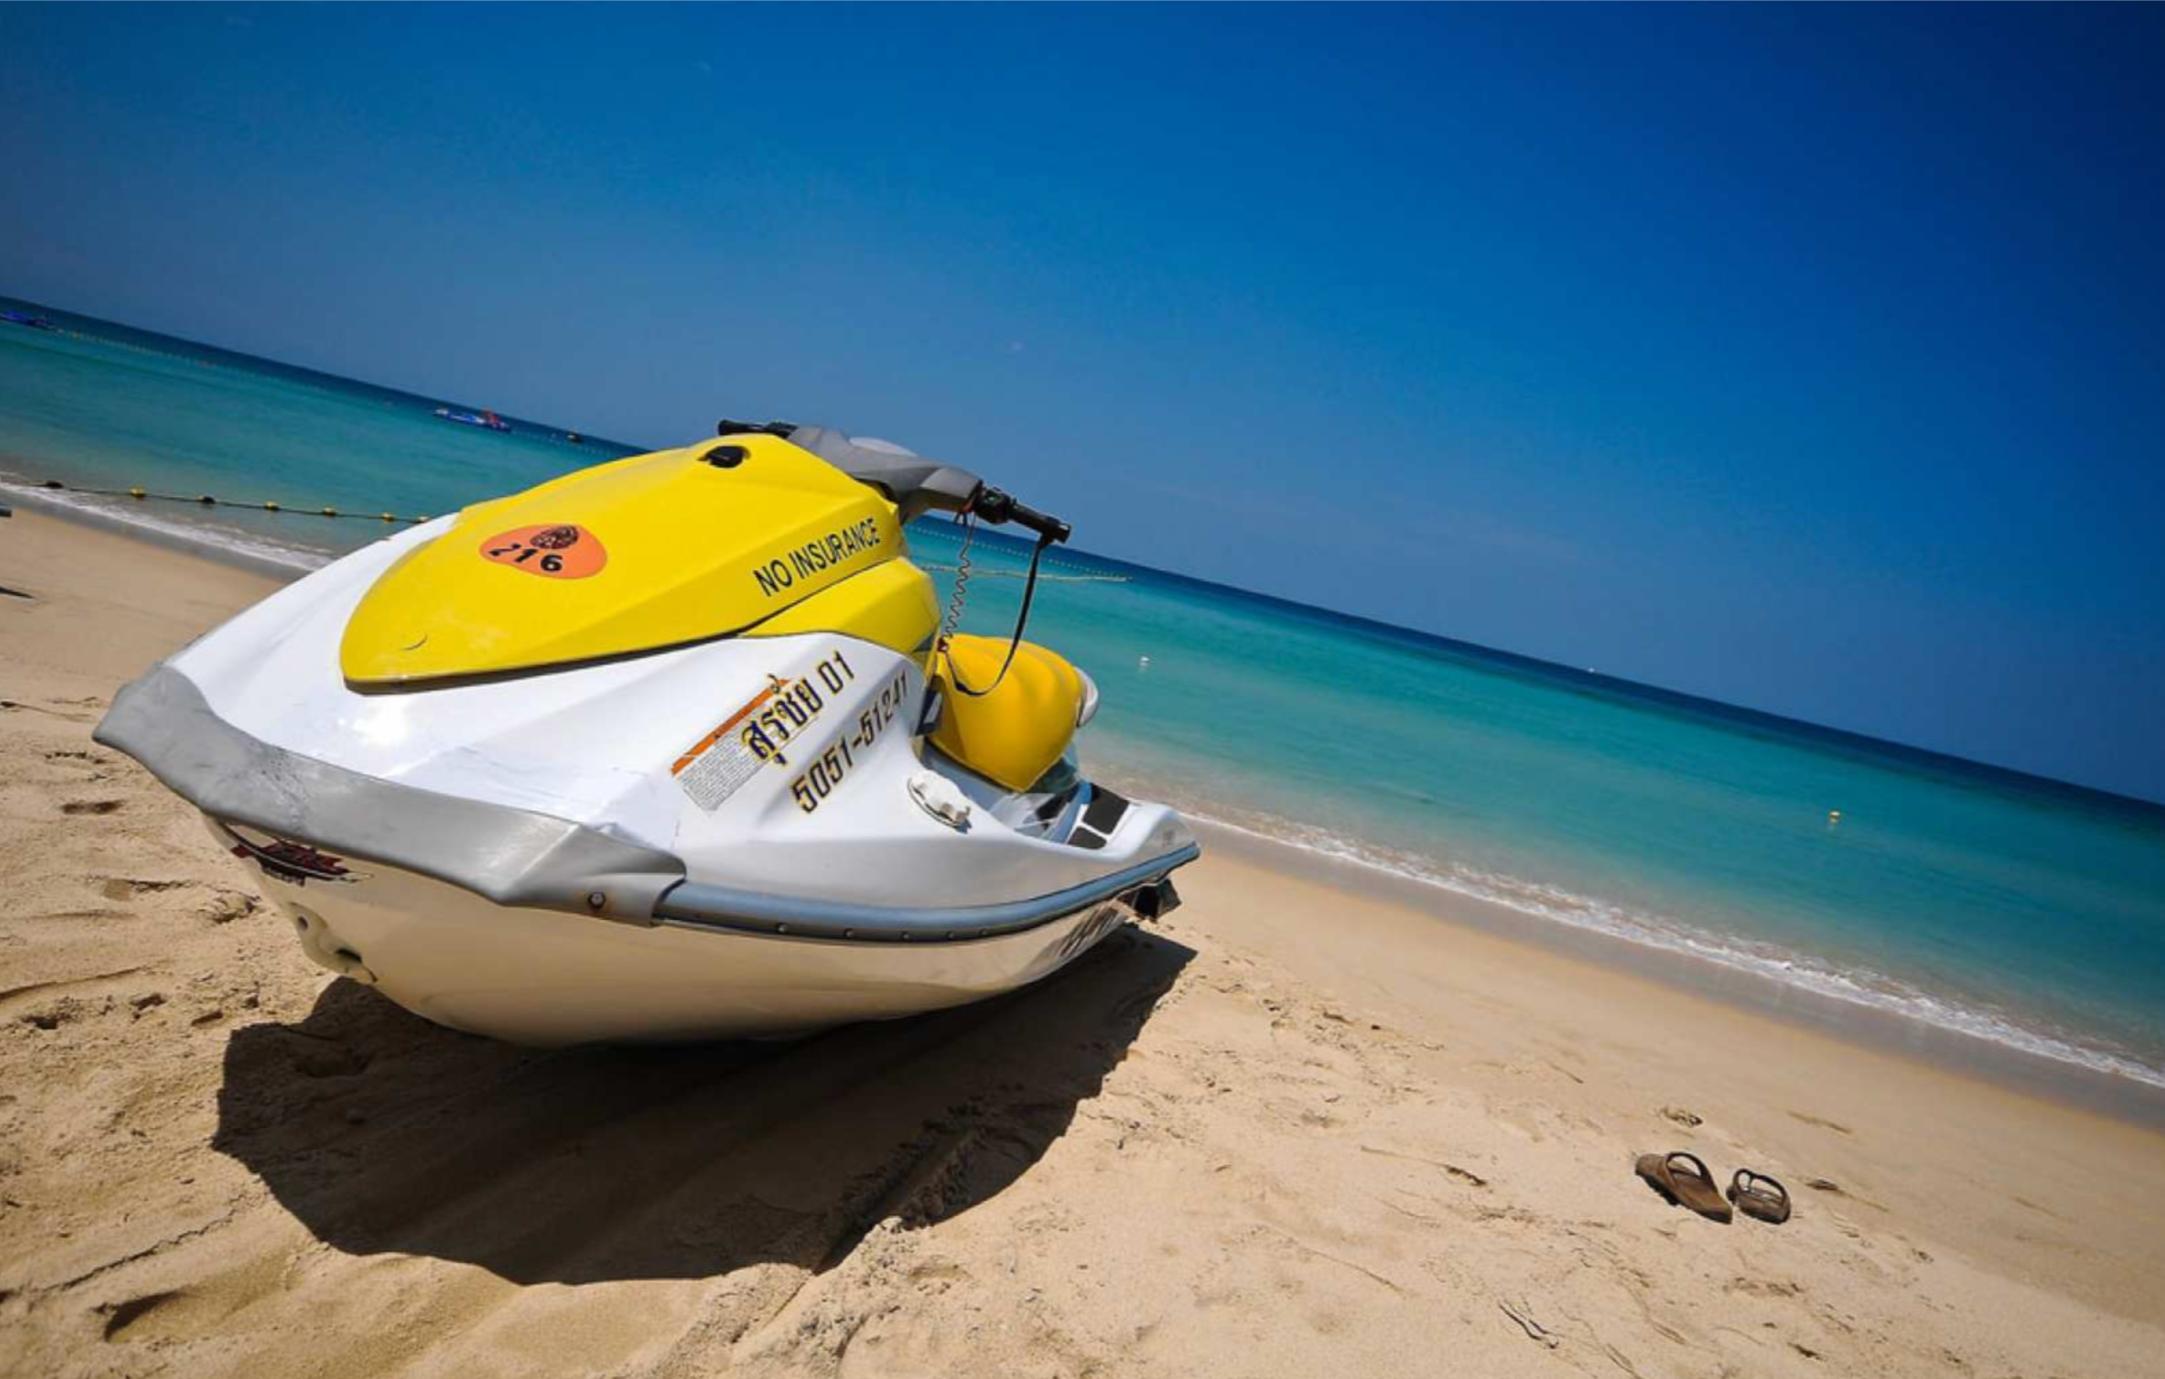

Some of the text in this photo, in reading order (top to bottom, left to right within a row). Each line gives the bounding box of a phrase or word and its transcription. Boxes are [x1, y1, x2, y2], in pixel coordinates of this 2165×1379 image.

[488, 543, 563, 572] 216
[753, 518, 881, 597] NO INSURANCE
[741, 673, 824, 766] สุรชัย
[791, 670, 908, 814] 5051-51241
